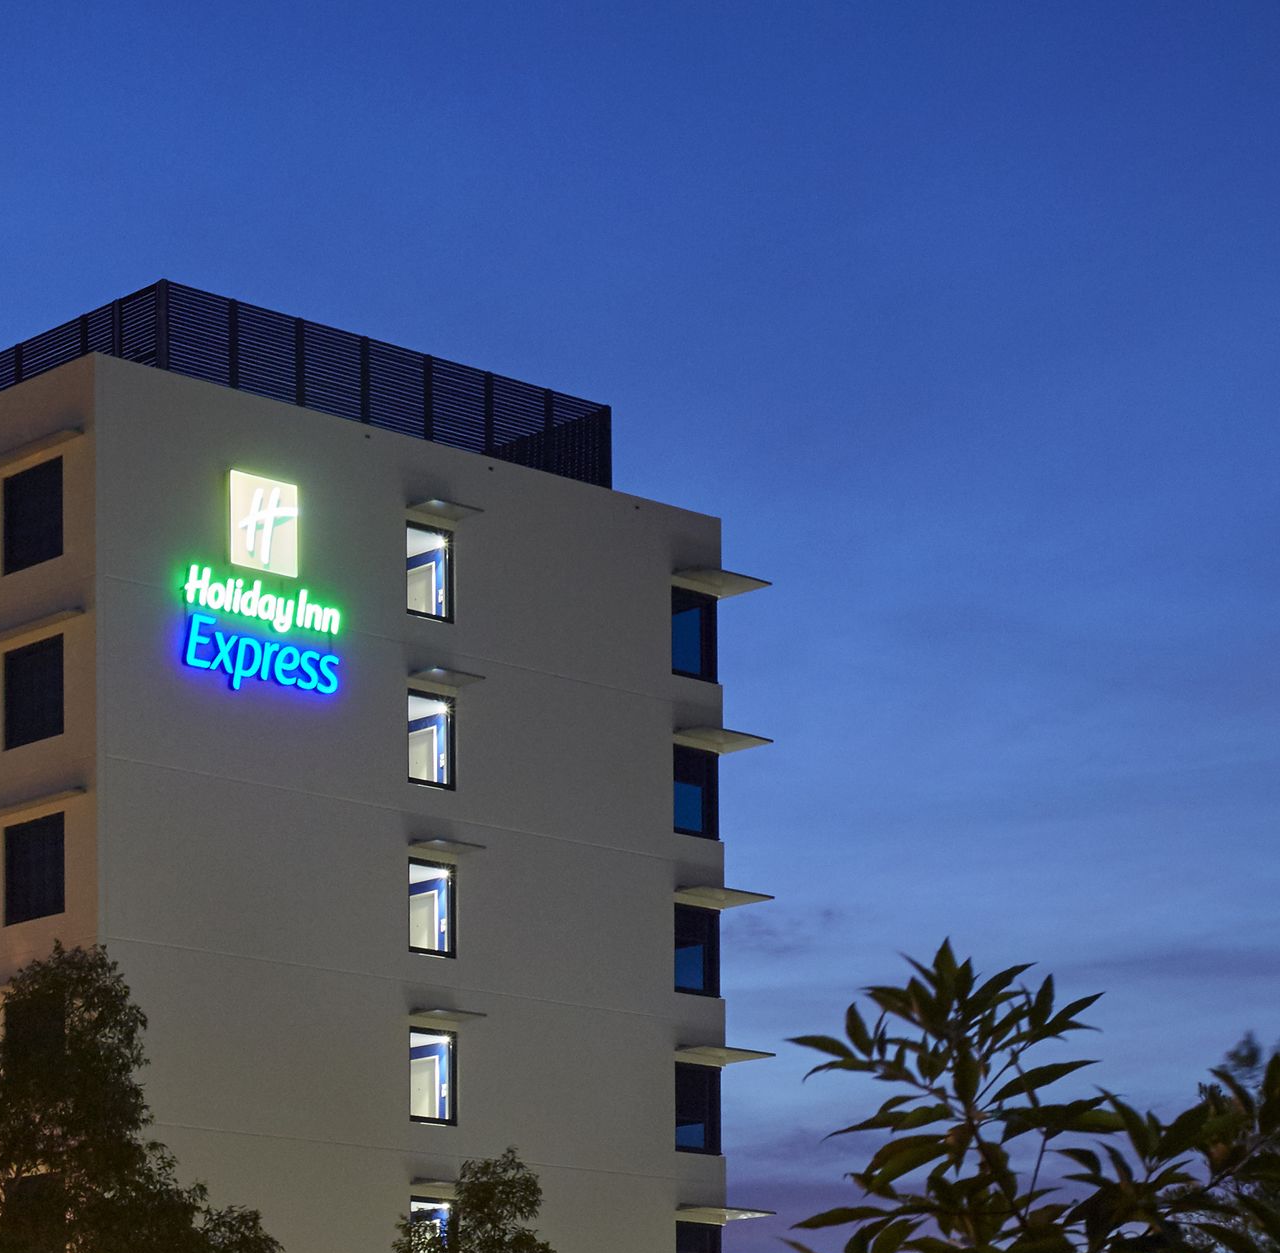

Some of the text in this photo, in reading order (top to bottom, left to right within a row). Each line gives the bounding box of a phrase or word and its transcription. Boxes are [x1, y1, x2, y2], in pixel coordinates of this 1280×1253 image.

[184, 564, 340, 635] Holiday Inn
[185, 613, 340, 694] Express
